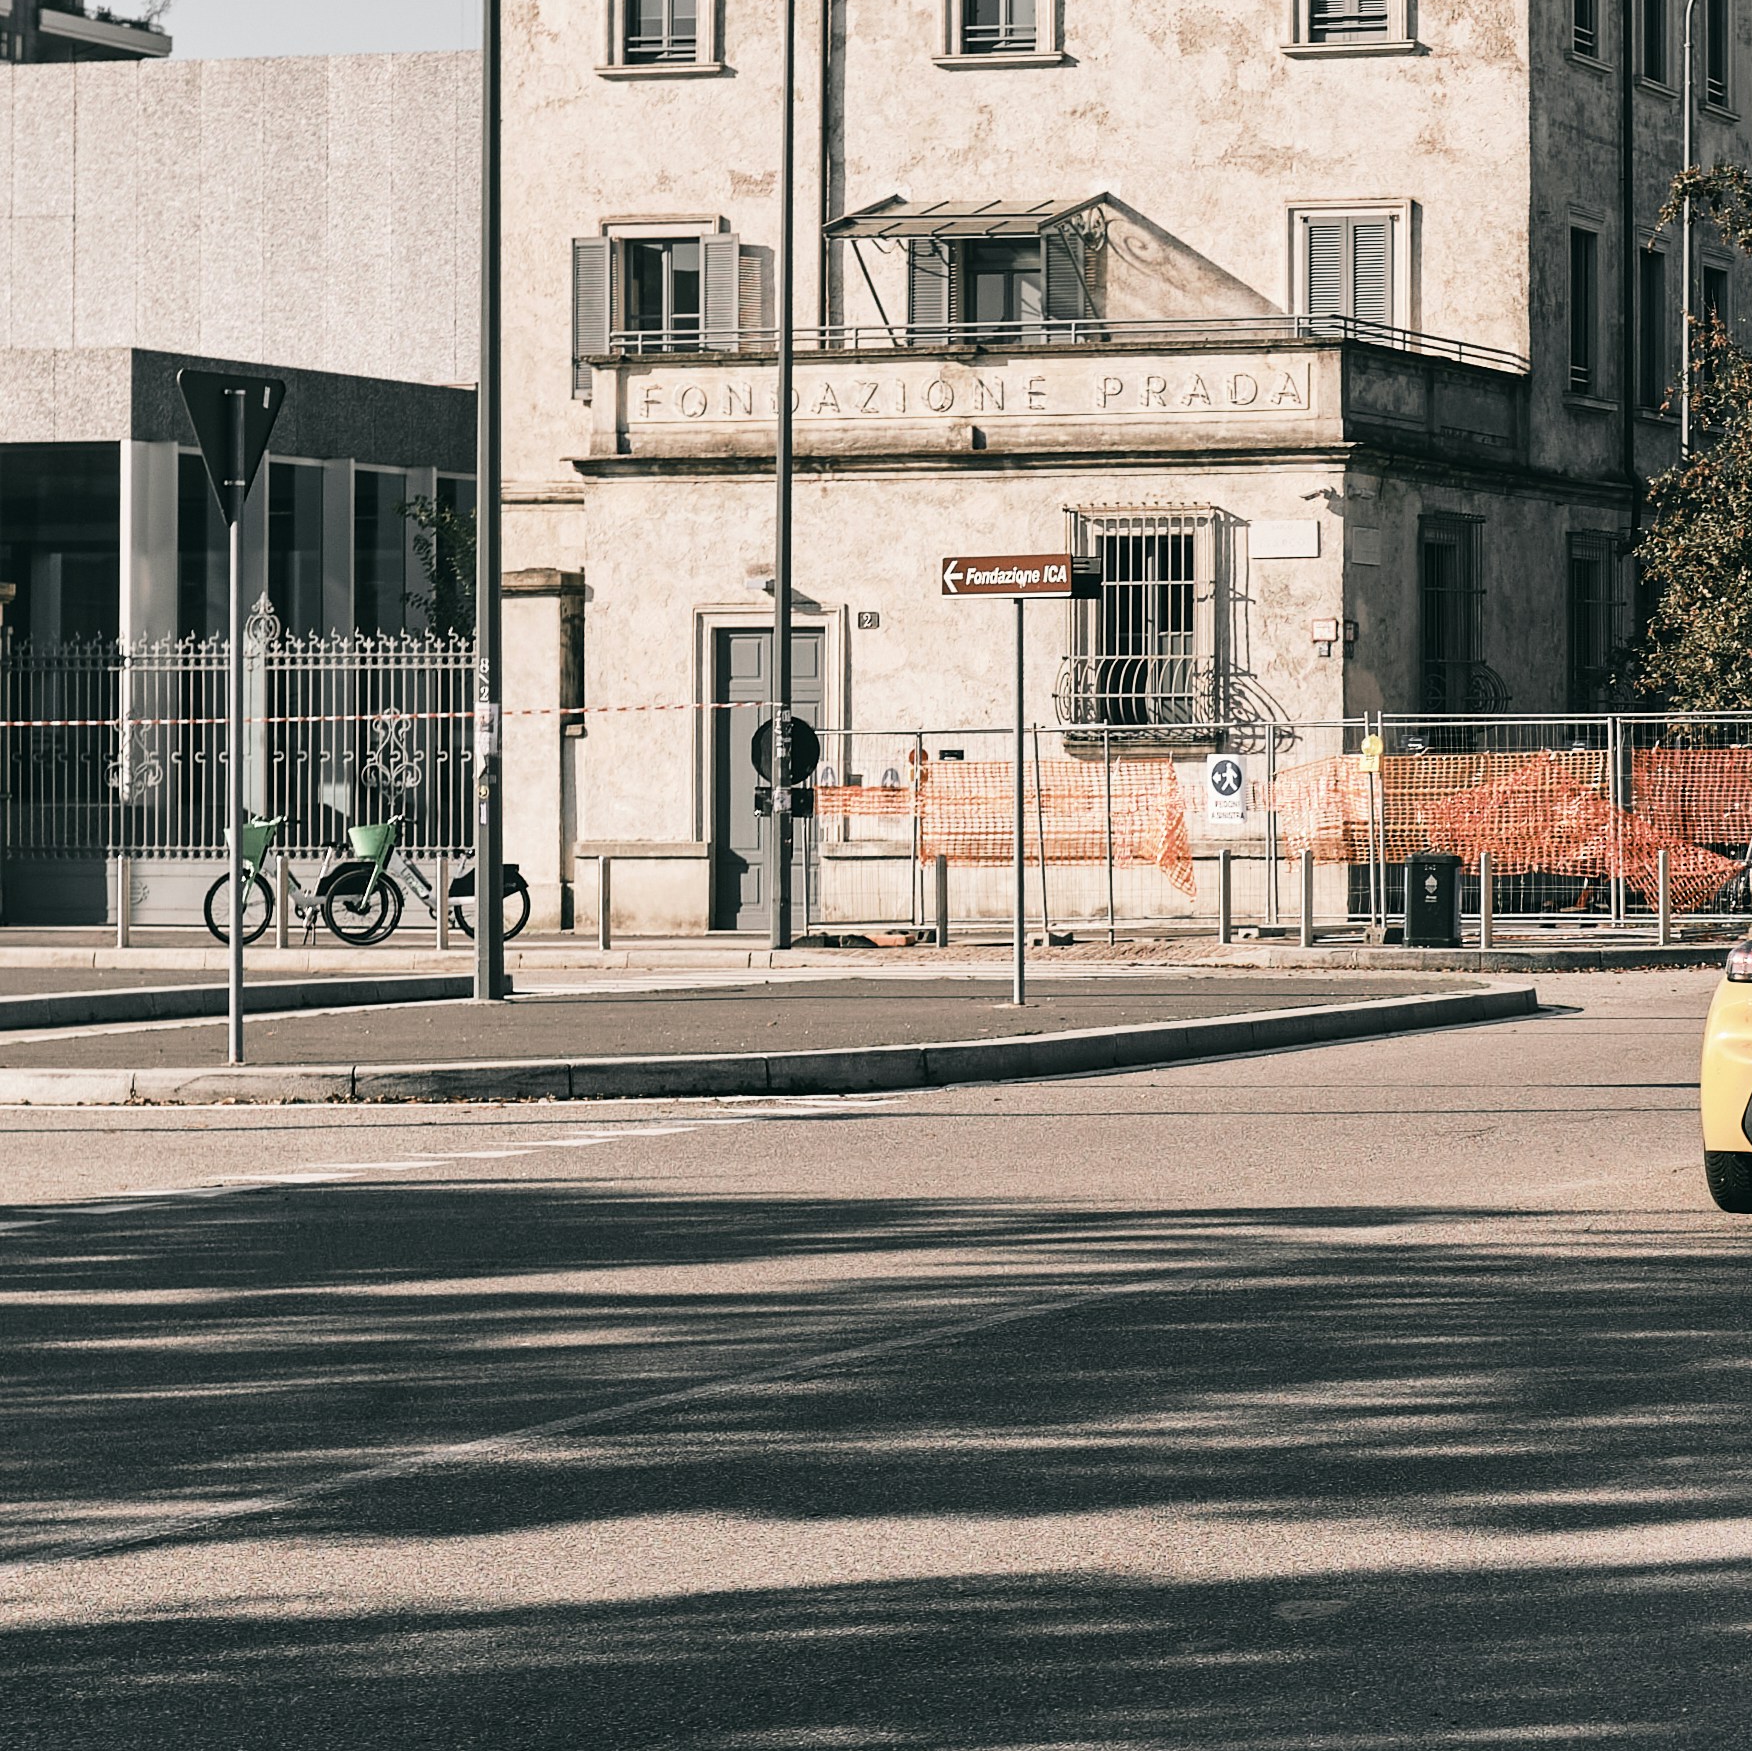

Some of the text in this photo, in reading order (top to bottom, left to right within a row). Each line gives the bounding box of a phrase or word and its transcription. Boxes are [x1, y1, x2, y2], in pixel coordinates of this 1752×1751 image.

[638, 370, 1304, 420] FONDAZIONE PRADA
[965, 564, 1068, 587] Fondazione ICA
[862, 612, 873, 629] 2
